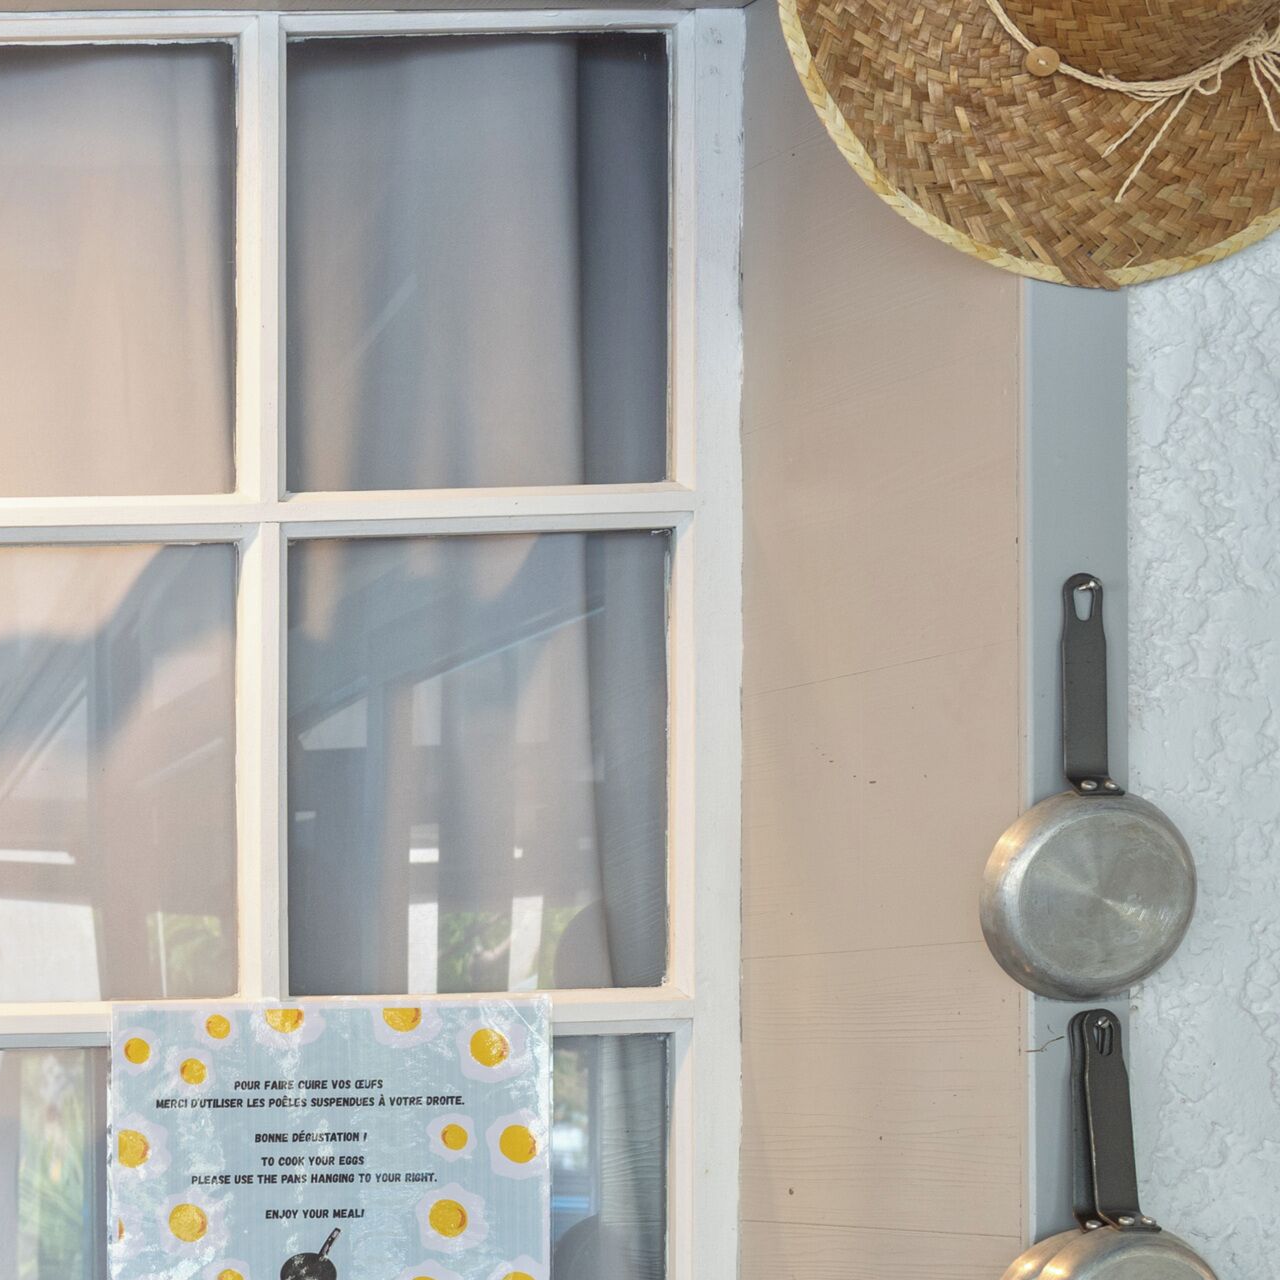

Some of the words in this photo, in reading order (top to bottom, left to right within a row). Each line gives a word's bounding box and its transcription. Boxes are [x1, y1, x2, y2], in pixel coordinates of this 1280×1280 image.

[234, 1081, 260, 1090] POUR
[264, 1080, 294, 1090] FAIRE
[298, 1080, 327, 1089] CUIRE
[331, 1080, 351, 1089] VOS
[355, 1079, 383, 1089] ŒUFS
[156, 1099, 187, 1108] MERCI
[191, 1098, 243, 1108] D'UTILISER
[247, 1098, 265, 1107] LES
[268, 1095, 307, 1108] POÊLES
[311, 1097, 374, 1107] SUSPENDUES
[378, 1094, 385, 1106] À
[389, 1096, 422, 1106] VOTRE
[426, 1096, 465, 1105] DROITE.
[255, 1133, 288, 1143] BONNE
[292, 1130, 359, 1142] DÉGUSTATION
[261, 1157, 274, 1166] TO
[278, 1156, 304, 1166] COOK
[308, 1156, 335, 1165] YOUR
[339, 1156, 364, 1165] EGGS
[192, 1175, 230, 1184] PLEASE
[234, 1175, 253, 1184] USE
[257, 1175, 277, 1184] THE
[281, 1174, 307, 1184] PANS
[311, 1173, 354, 1183] HANGING
[358, 1173, 371, 1183] TO
[375, 1173, 401, 1182] YOUR
[405, 1173, 437, 1182] RIGHT.
[265, 1210, 298, 1219] ENJOY
[302, 1209, 329, 1218] YOUR
[333, 1209, 365, 1218] MEAL!
